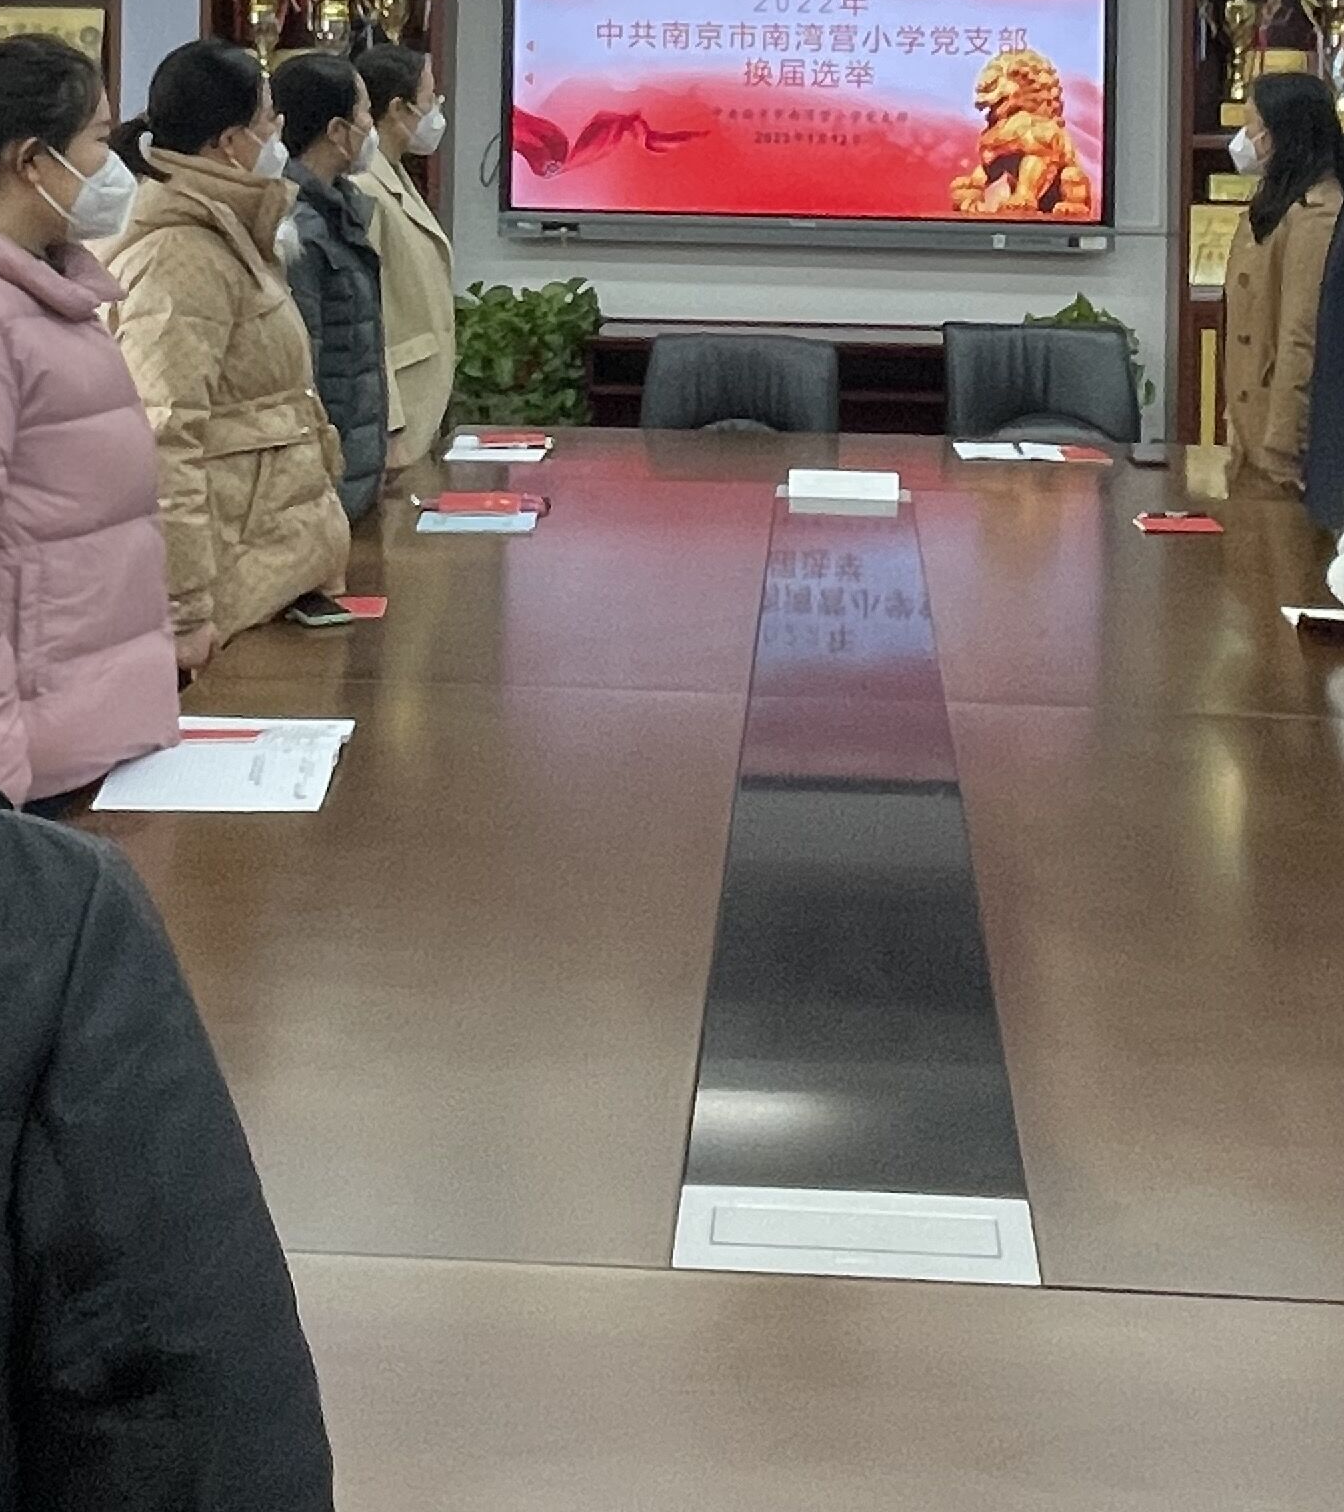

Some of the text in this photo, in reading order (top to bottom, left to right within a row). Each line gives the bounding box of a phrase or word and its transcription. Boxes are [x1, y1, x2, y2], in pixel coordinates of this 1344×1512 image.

[596, 18, 1028, 57] 中共南京市南湾营小学党支部
[743, 58, 875, 89] 换届选举
